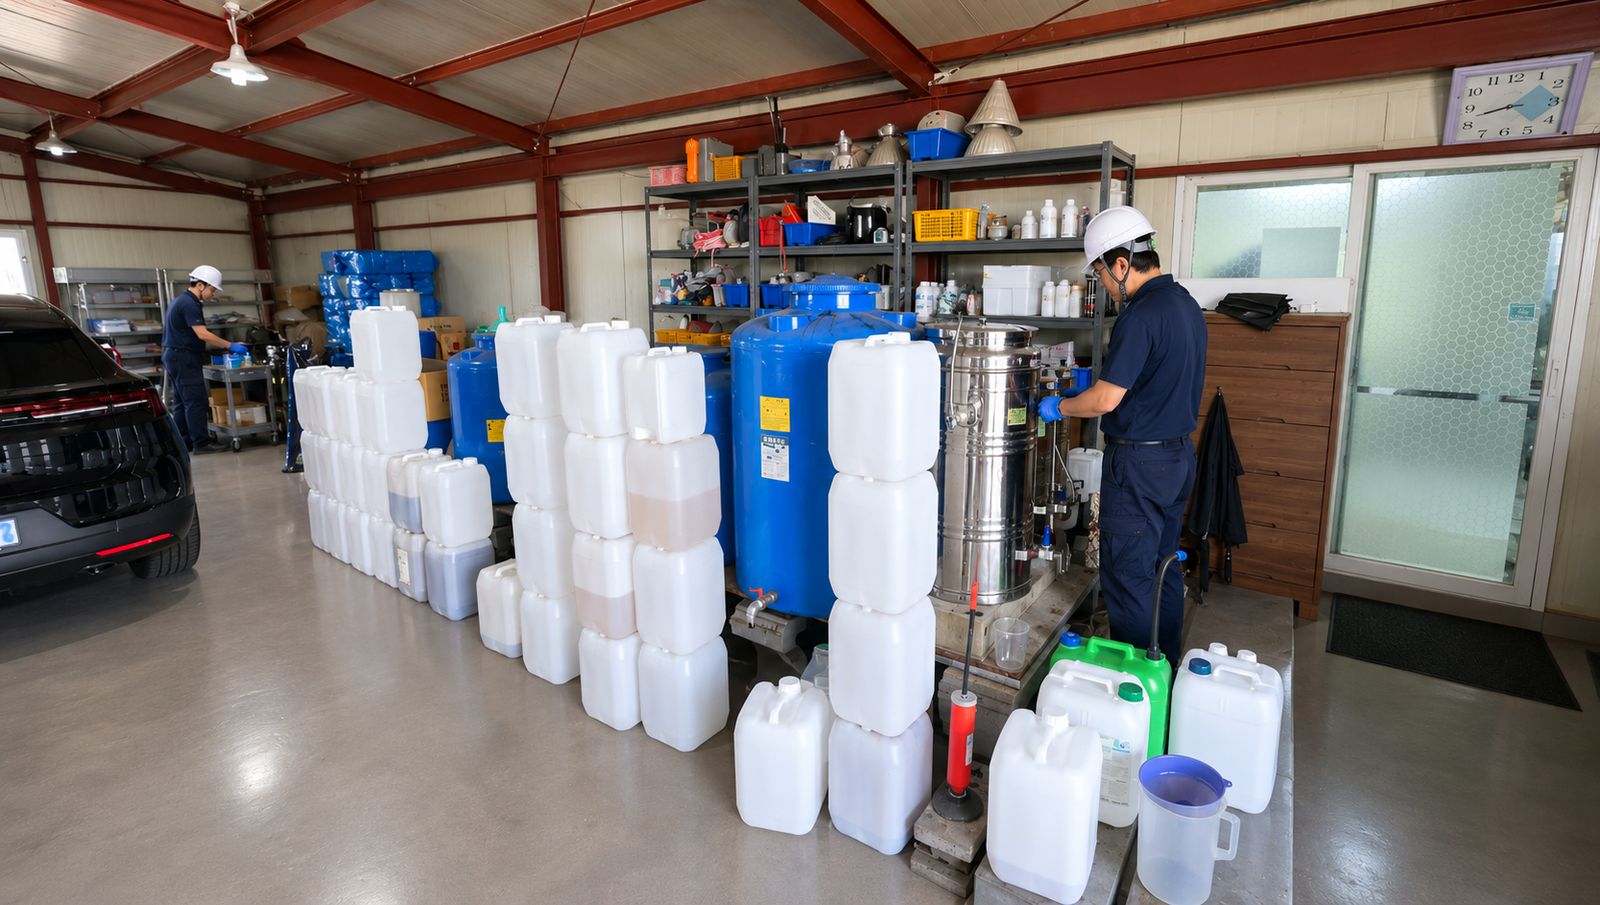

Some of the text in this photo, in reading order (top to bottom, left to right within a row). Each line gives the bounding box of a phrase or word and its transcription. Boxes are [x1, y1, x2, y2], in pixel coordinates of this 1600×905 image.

[1488, 76, 1499, 85] 11
[1508, 73, 1525, 83] 12
[1538, 72, 1544, 80] 1
[1552, 79, 1564, 88] 2
[1468, 87, 1483, 97] 10
[1548, 97, 1560, 107] 3
[1465, 105, 1475, 114] 9
[1543, 115, 1554, 124] 4
[1462, 121, 1473, 130] 8
[1477, 130, 1487, 138] 7
[1499, 127, 1510, 136] 6
[1522, 126, 1533, 135] 5
